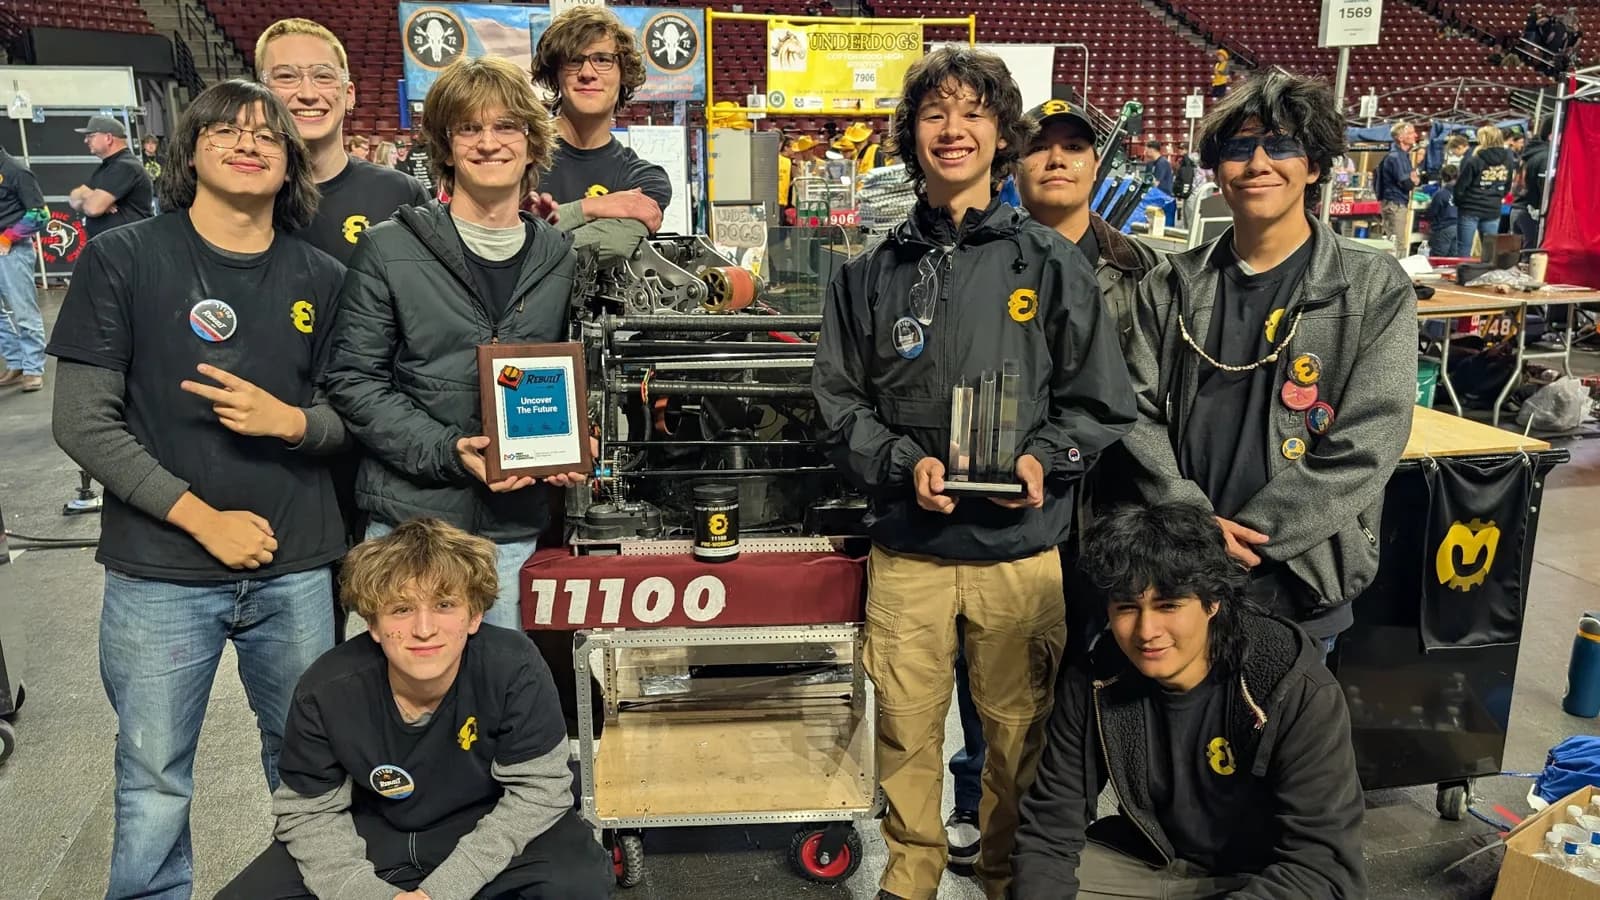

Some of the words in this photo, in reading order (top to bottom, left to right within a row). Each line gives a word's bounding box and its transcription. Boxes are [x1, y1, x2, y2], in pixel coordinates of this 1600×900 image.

[1339, 7, 1373, 19] 1569
[414, 36, 423, 45] 29
[448, 36, 457, 45] 72
[651, 39, 660, 48] 29
[682, 39, 691, 48] 72
[807, 32, 919, 51] UNDERDOGS
[855, 73, 876, 82] 7906
[716, 223, 763, 244] DOGS
[520, 396, 553, 405] Uncover
[516, 406, 532, 414] The
[532, 405, 558, 413] Future
[531, 575, 727, 625] 11100
